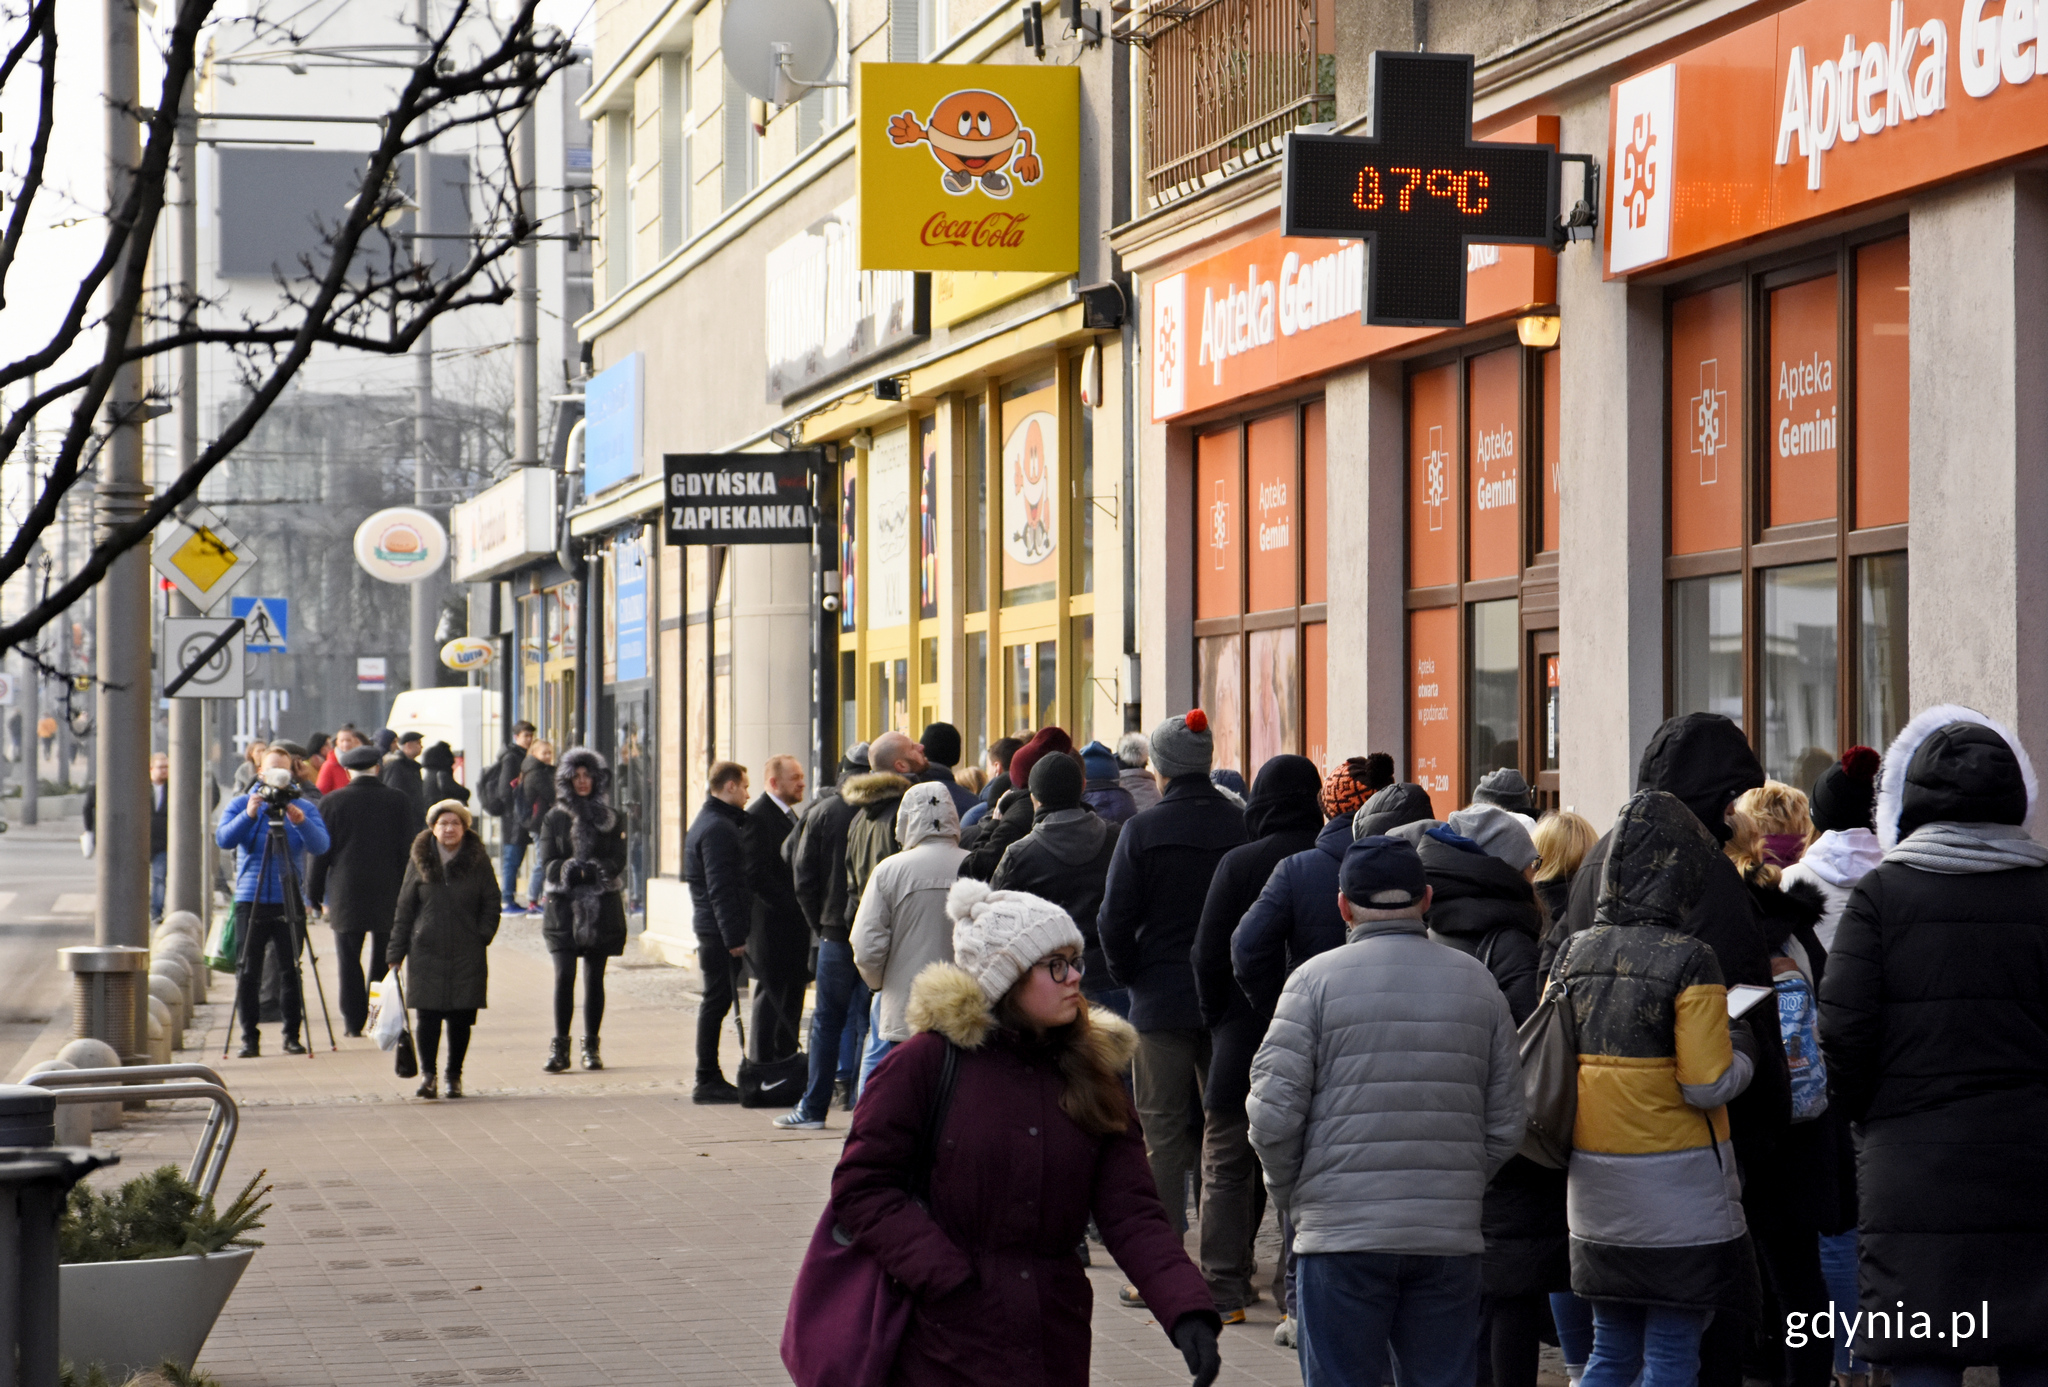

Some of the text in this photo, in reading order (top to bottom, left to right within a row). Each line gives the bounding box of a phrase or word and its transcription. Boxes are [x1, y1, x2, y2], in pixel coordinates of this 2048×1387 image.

[1775, 0, 2048, 191] Apteka Ge
[920, 211, 1030, 248] Coca-Cola
[1199, 239, 1363, 385] Apteka Gemin
[1778, 351, 1832, 410] Apteka
[1477, 423, 1513, 471] Apteka
[1778, 406, 1836, 458] Gemini
[671, 468, 777, 496] GDYŃSKA
[1259, 477, 1287, 518] Apteka
[1477, 469, 1516, 510] Gemini
[671, 504, 807, 529] ZAPIEKANKA
[1259, 516, 1289, 552] Gemini
[1418, 657, 1434, 679] Apteka
[1418, 682, 1439, 698] otwarta
